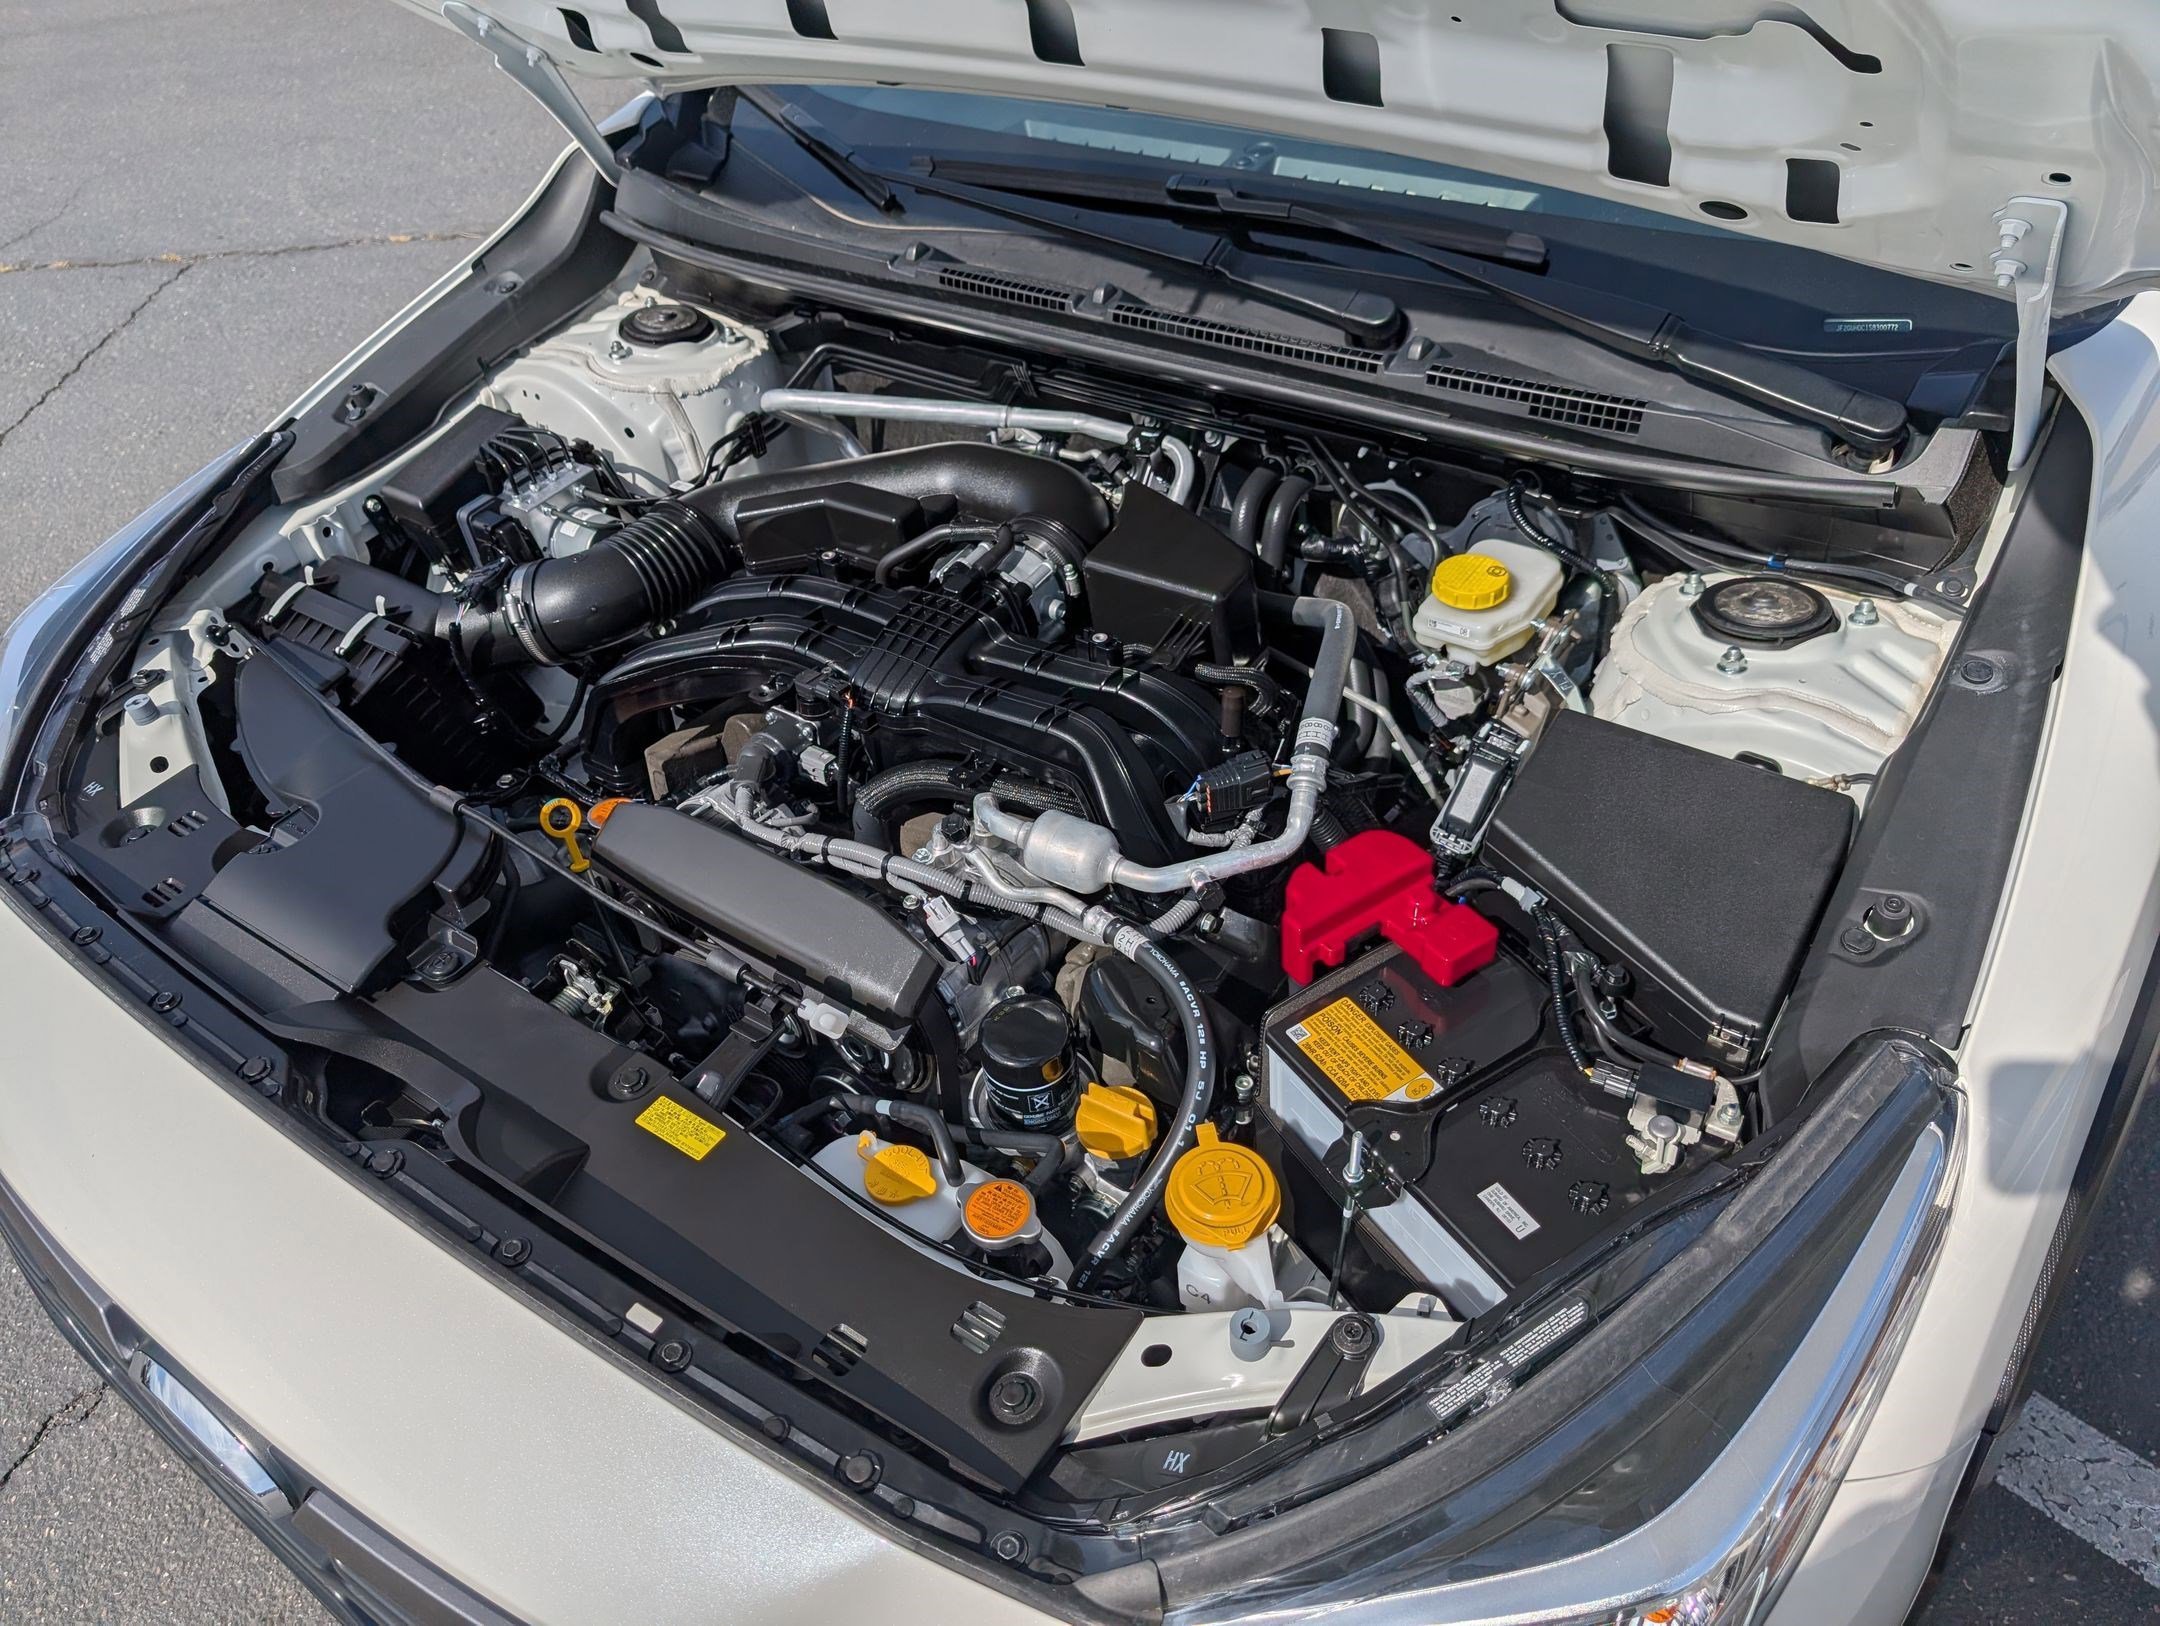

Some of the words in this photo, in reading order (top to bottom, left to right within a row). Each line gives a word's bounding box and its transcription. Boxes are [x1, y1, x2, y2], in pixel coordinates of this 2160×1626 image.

[83, 781, 104, 796] HX
[1150, 947, 1179, 978] YOKOHAMA
[1200, 1051, 1207, 1070] HP
[1339, 998, 1367, 1023] DANGER
[1363, 1022, 1387, 1043] EXPLOSIVE
[1383, 1040, 1400, 1055] GASES
[1311, 1039, 1325, 1051] KEEP
[1334, 1062, 1351, 1077] REACH
[1317, 1012, 1343, 1035] POISON
[1341, 1035, 1360, 1052] CAUSES
[1356, 1049, 1375, 1066] SEVERE
[1371, 1064, 1388, 1079] BURNS
[1317, 1036, 1330, 1047] KEEP
[1327, 1046, 1340, 1057] VENT
[1337, 1056, 1350, 1067] CAPS
[1347, 1066, 1362, 1078] TIGHT
[1120, 1186, 1157, 1226] YOKOHAMA
[1163, 1450, 1190, 1473] HX
